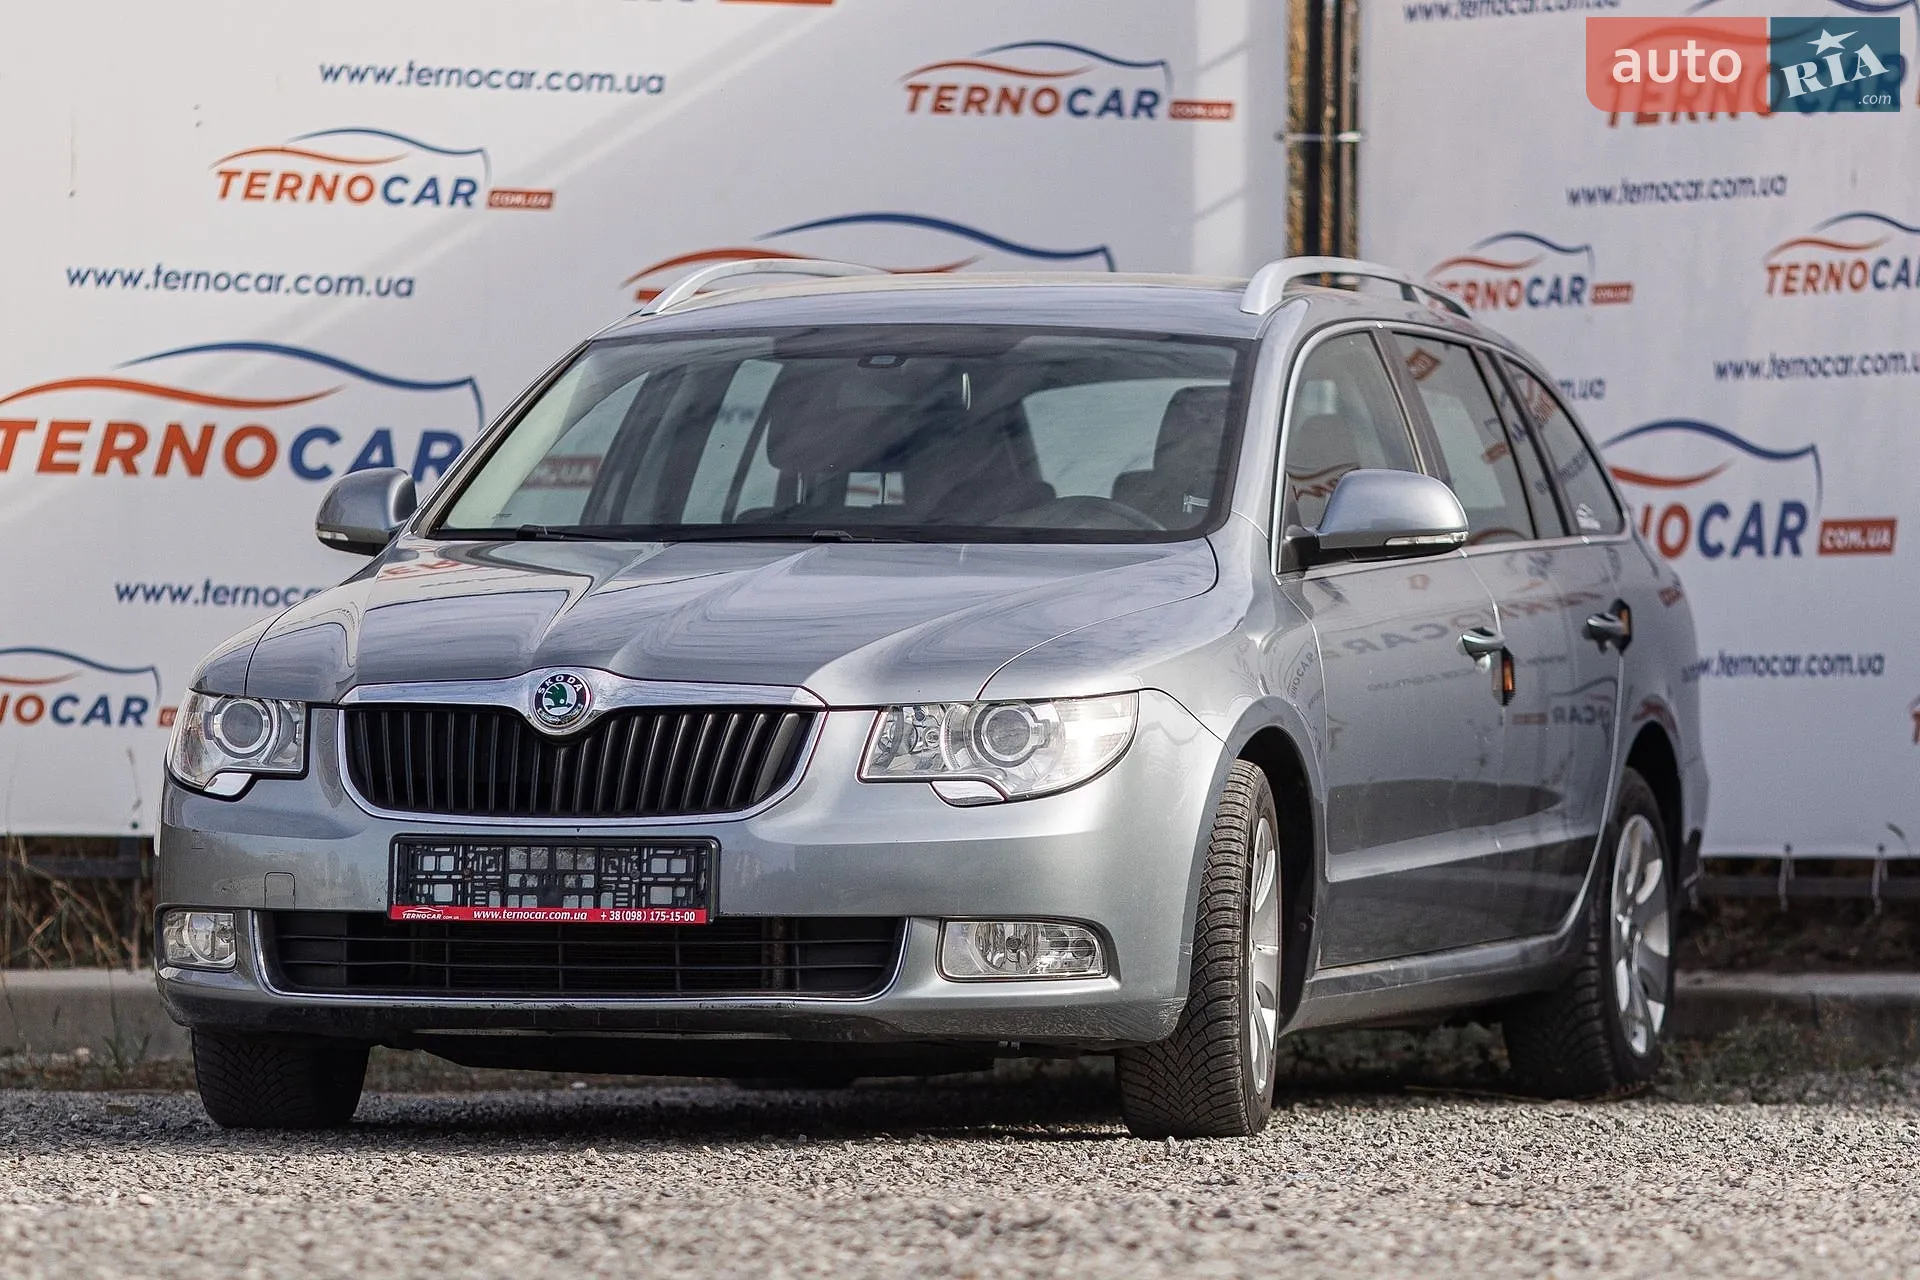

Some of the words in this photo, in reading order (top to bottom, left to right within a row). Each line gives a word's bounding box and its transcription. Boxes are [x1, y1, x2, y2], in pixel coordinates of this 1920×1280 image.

[319, 60, 666, 95] www.ternocar.com.ua
[905, 84, 1160, 121] TERNOCAR
[216, 170, 478, 208] TERNOCAR
[66, 263, 416, 298] www.ternocar.com.ua
[473, 909, 588, 921] www.ternocar.com.ua
[649, 911, 696, 922] 175-15-00
